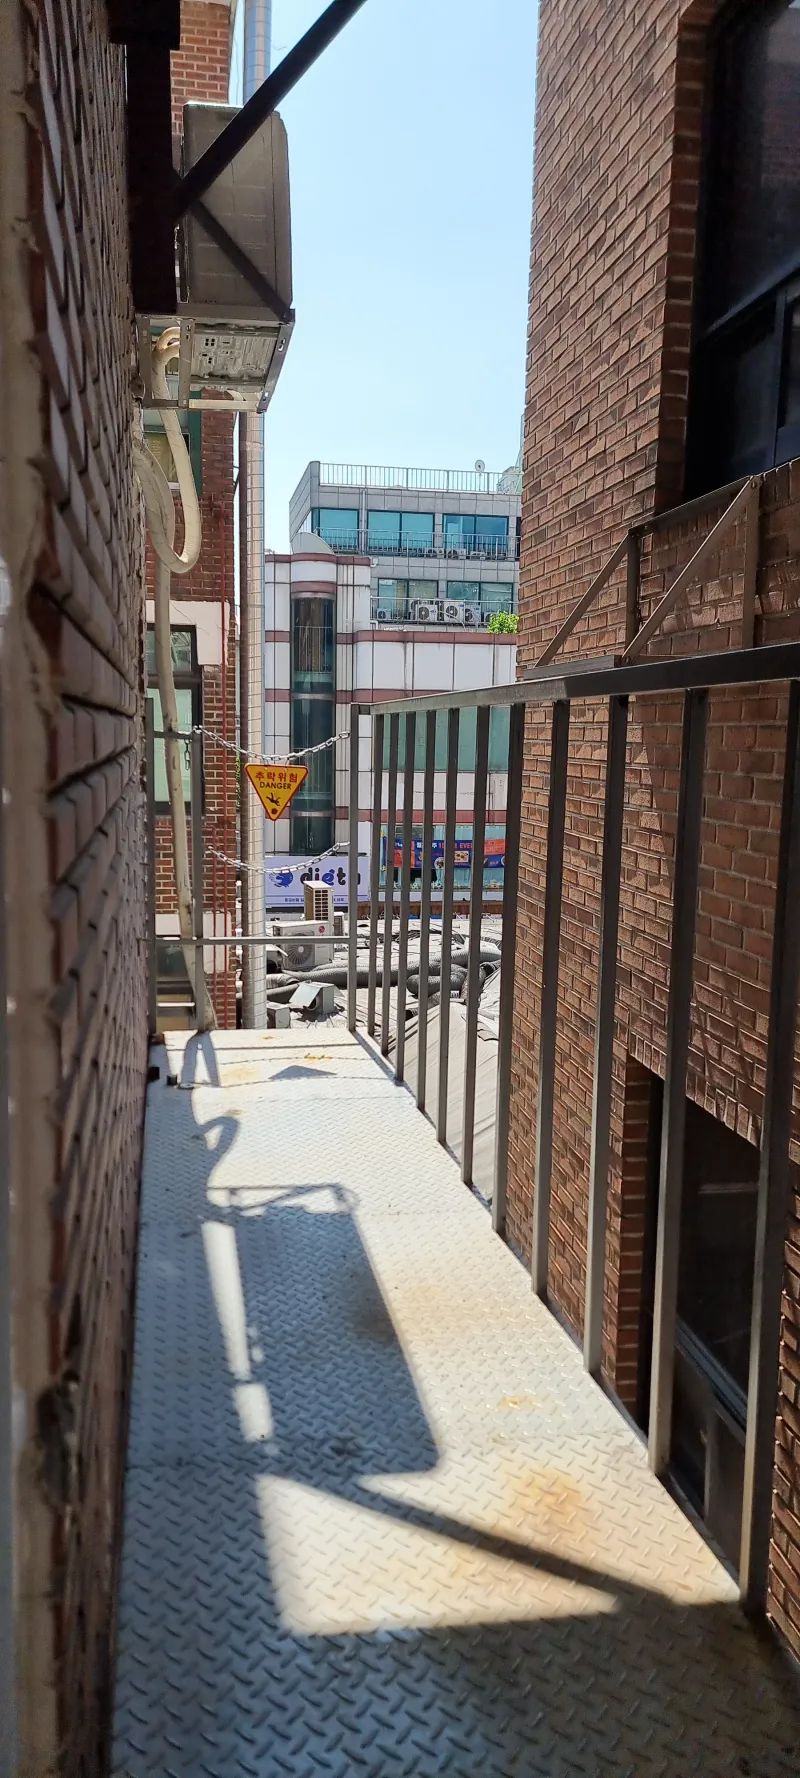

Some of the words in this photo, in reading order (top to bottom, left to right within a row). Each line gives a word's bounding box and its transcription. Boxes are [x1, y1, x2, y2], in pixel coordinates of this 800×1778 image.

[255, 771, 298, 783] 추락위험
[260, 782, 292, 790] DANGER
[300, 867, 361, 886] diet
